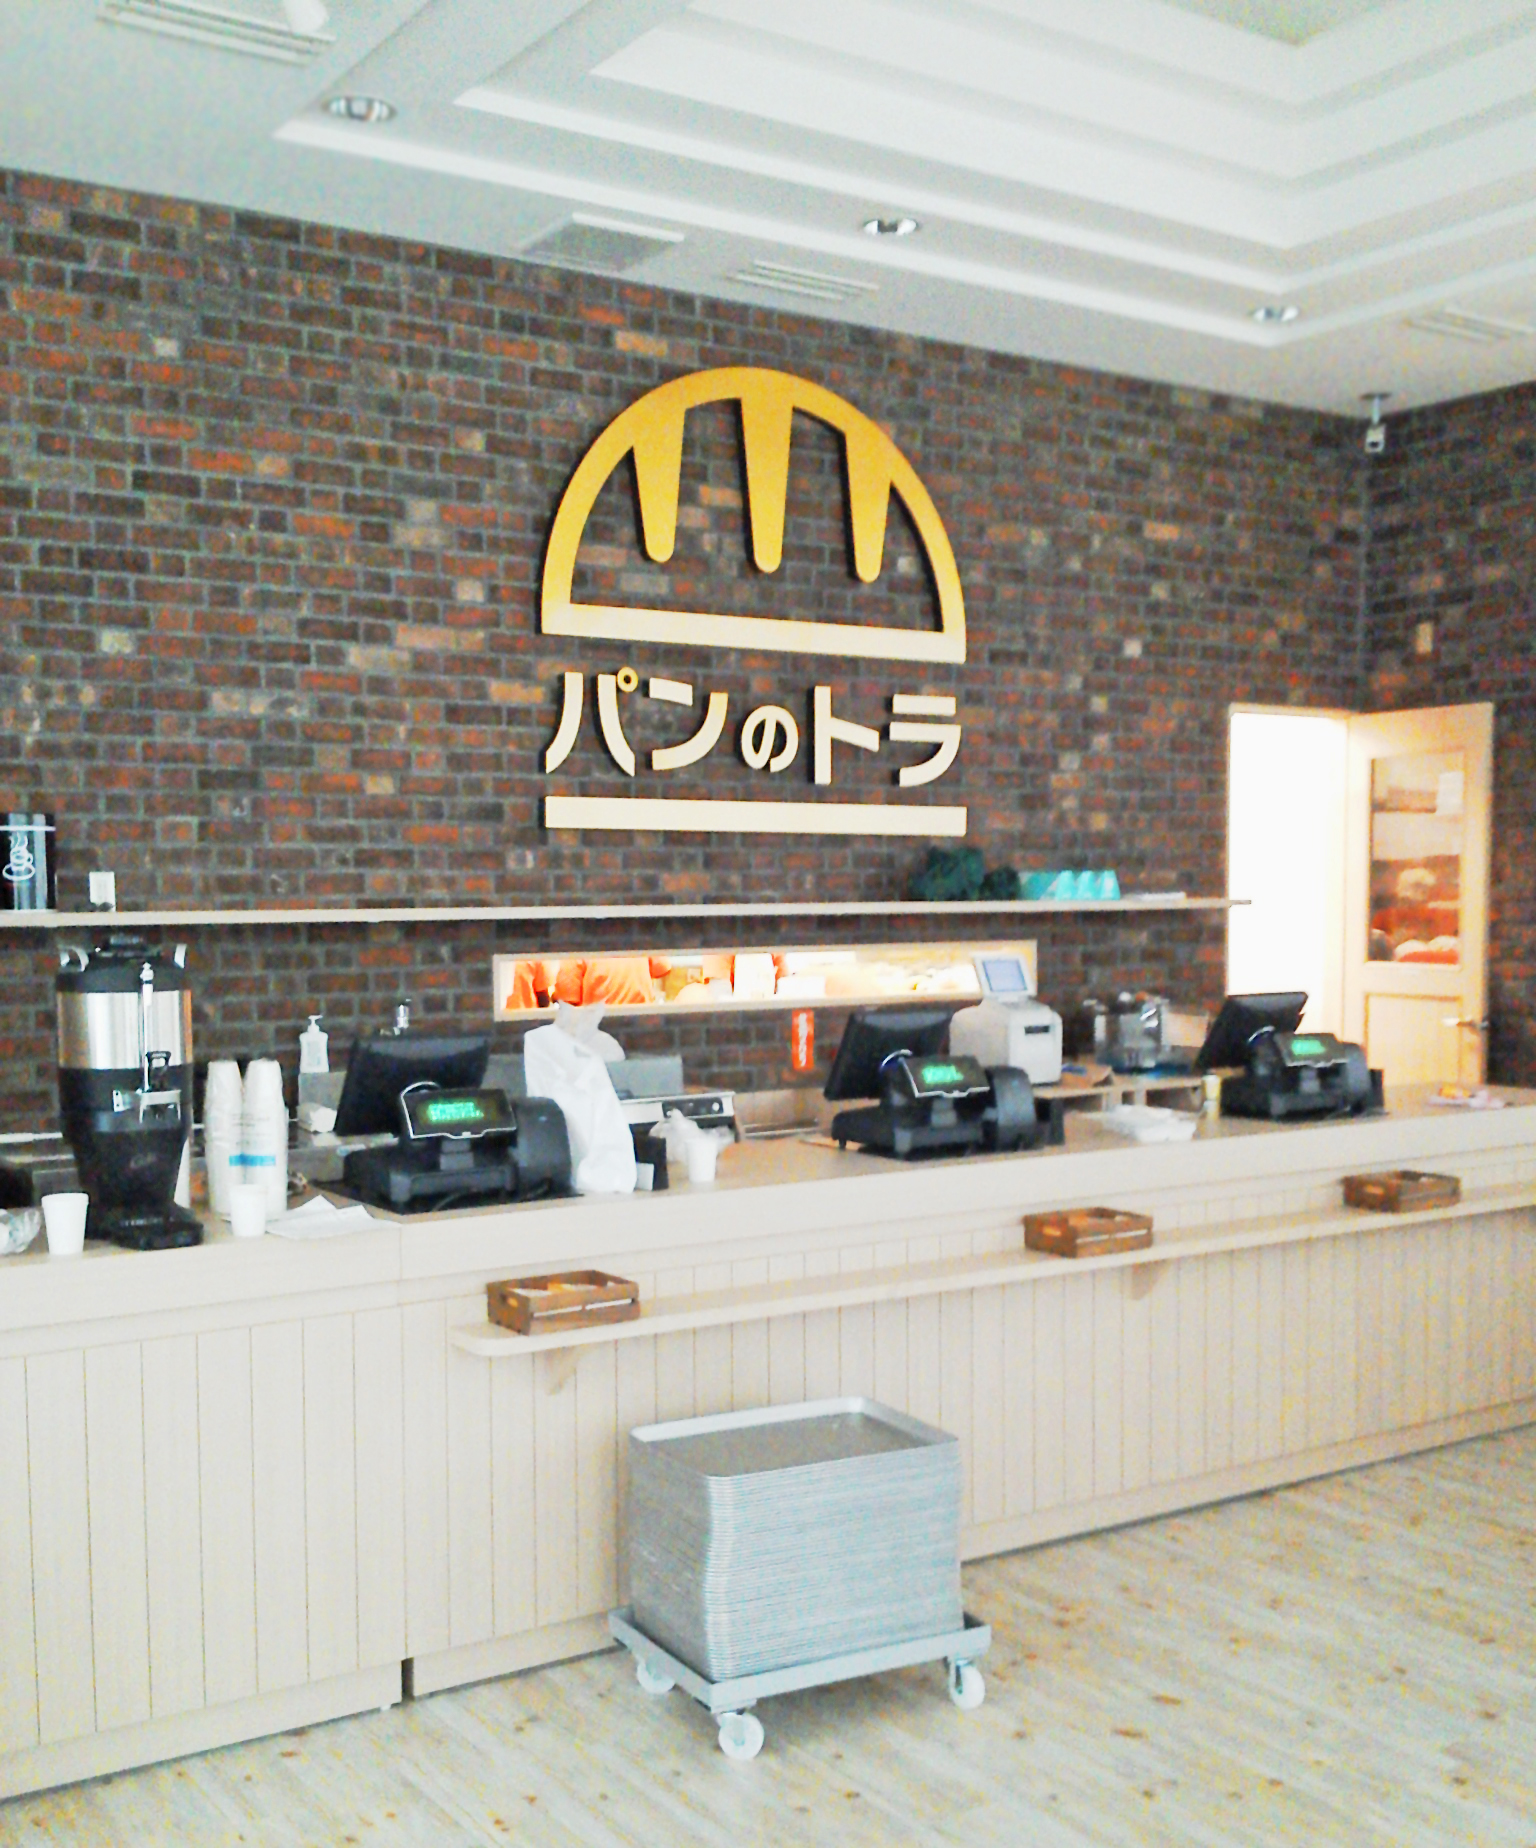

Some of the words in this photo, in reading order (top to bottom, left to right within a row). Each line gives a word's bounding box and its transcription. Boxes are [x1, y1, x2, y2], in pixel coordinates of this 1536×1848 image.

[546, 666, 961, 787] パンのトラ
